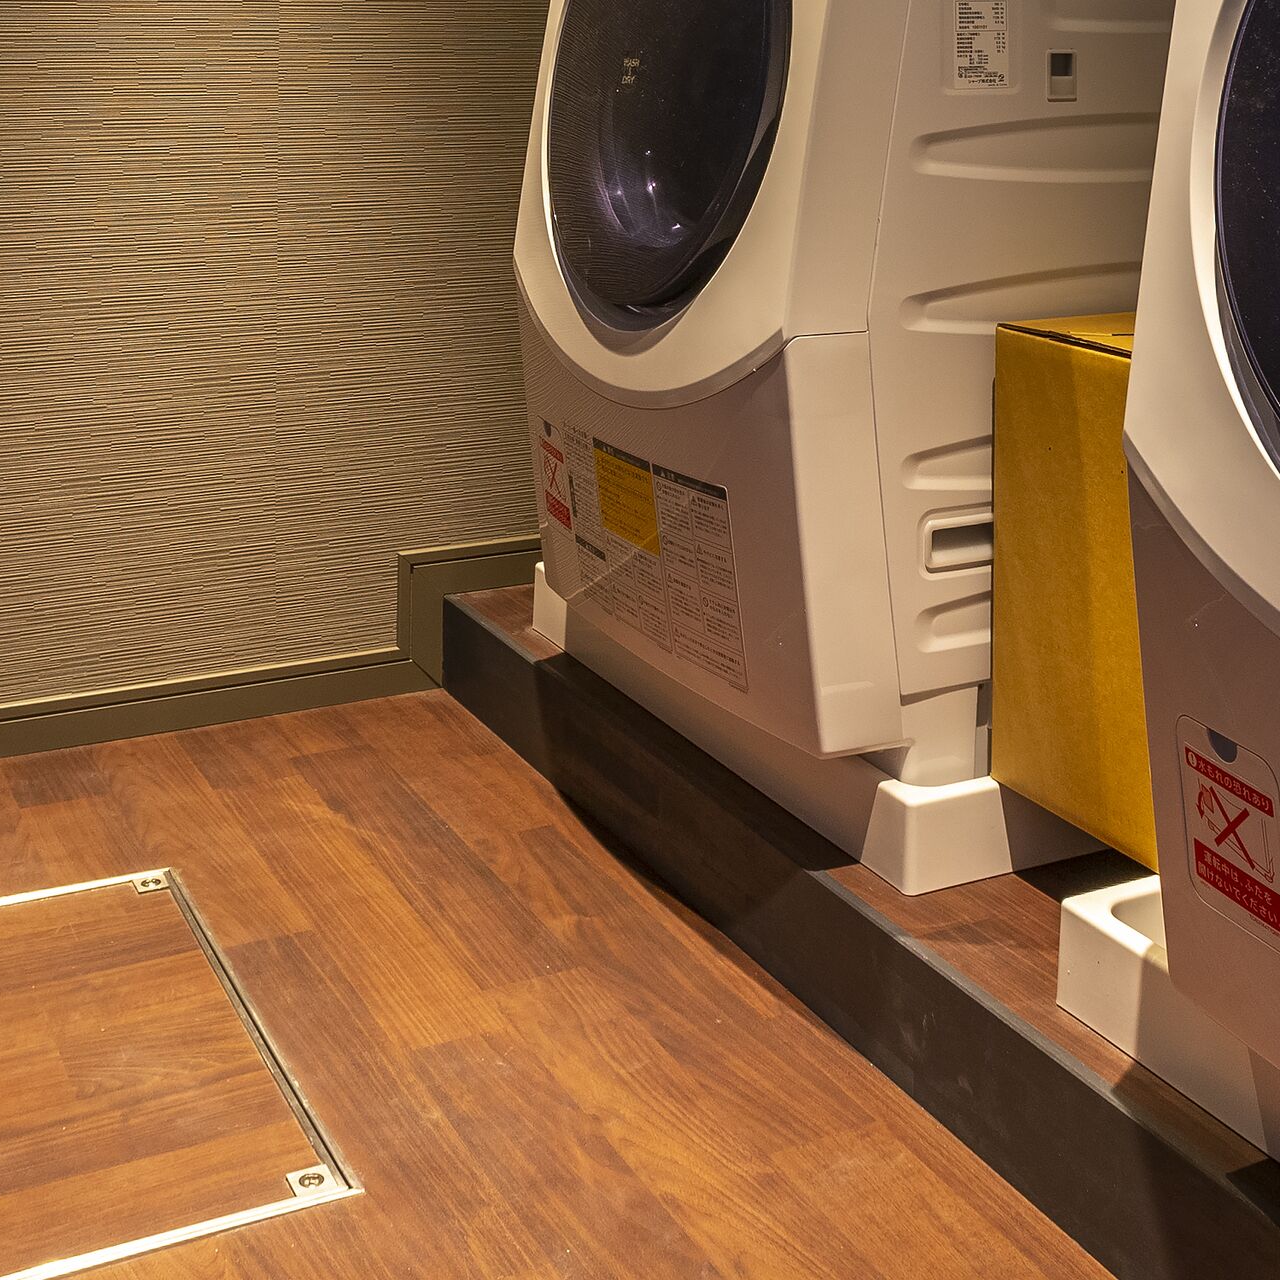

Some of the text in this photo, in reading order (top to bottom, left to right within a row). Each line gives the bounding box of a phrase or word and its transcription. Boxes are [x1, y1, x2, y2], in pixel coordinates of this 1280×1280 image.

[1198, 760, 1268, 811] 水もれの恐れあり
[1198, 860, 1280, 928] 開けないでください。
[1204, 849, 1271, 905] 運転中は、ふたを
